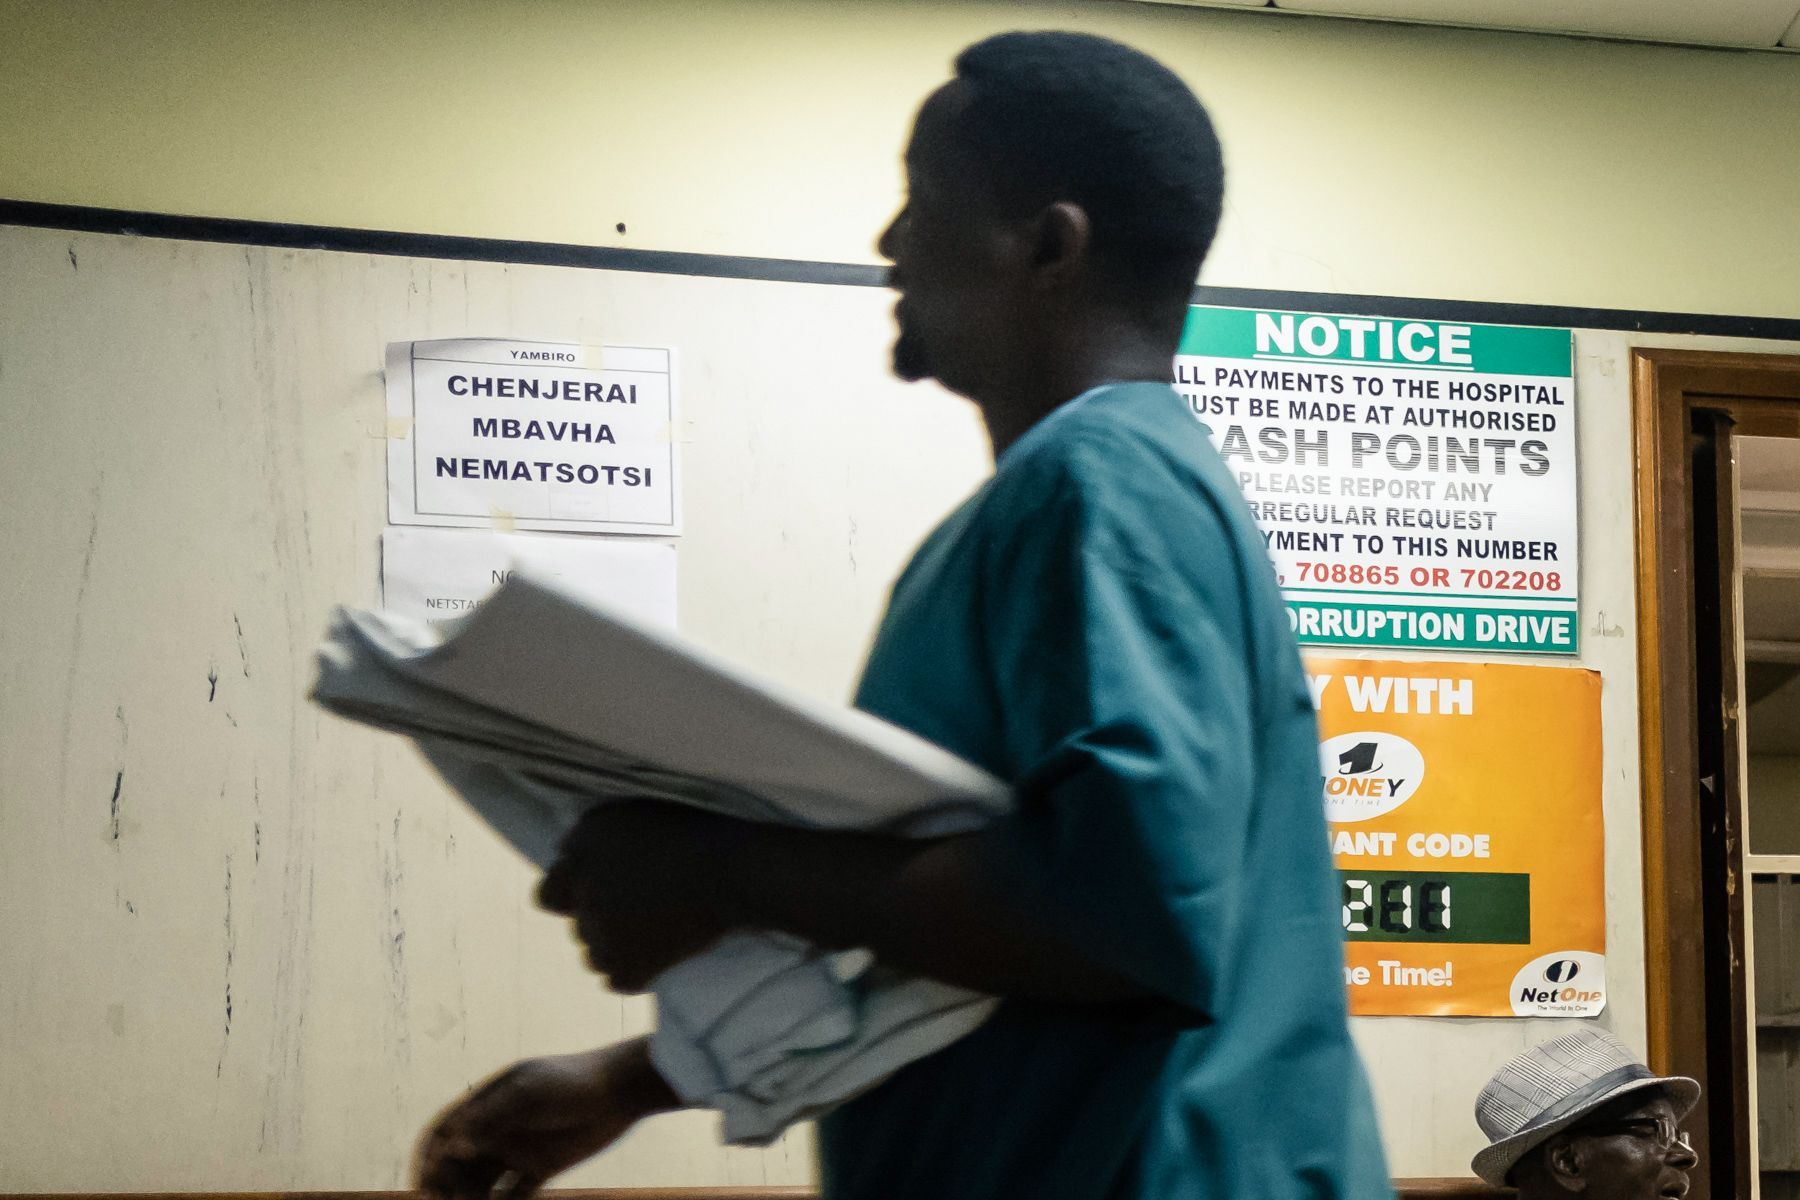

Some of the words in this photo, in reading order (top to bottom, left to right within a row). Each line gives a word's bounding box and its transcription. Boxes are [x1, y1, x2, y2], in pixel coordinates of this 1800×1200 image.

[1255, 313, 1473, 364] NOTICE
[510, 350, 576, 362] YAMBIRO
[447, 375, 637, 404] CHENJERAI
[1215, 367, 1344, 394] PAYMENTS
[1352, 376, 1384, 396] TO
[1392, 378, 1439, 399] THE
[1449, 381, 1564, 405] HOSPITAL
[472, 417, 616, 444] MBAVHA
[1250, 398, 1279, 418] BE
[1289, 400, 1356, 423] MADE
[1365, 405, 1394, 425] AT
[1403, 407, 1556, 432] AUTHORISED
[1351, 432, 1550, 477] POINTS
[435, 456, 652, 488] NEMATSOTSI
[1239, 471, 1331, 495] PLEASE
[1340, 476, 1436, 500] REPORT
[1444, 481, 1493, 502] ANY
[1248, 500, 1377, 526] RREGULAR
[1386, 507, 1497, 531] REQUEST
[1260, 530, 1344, 552] YMENT
[1352, 534, 1384, 554] TO
[1392, 536, 1448, 556] THIS
[1457, 539, 1558, 561] NUMBER
[1296, 562, 1400, 586] 708865
[1410, 567, 1450, 587] OR
[1460, 569, 1562, 591] 702208
[1475, 613, 1571, 644] DRIVE
[1344, 675, 1473, 715] WITH
[1406, 832, 1490, 858] CODE
[1377, 960, 1453, 988] Time!
[1520, 987, 1602, 1003] NetOne
